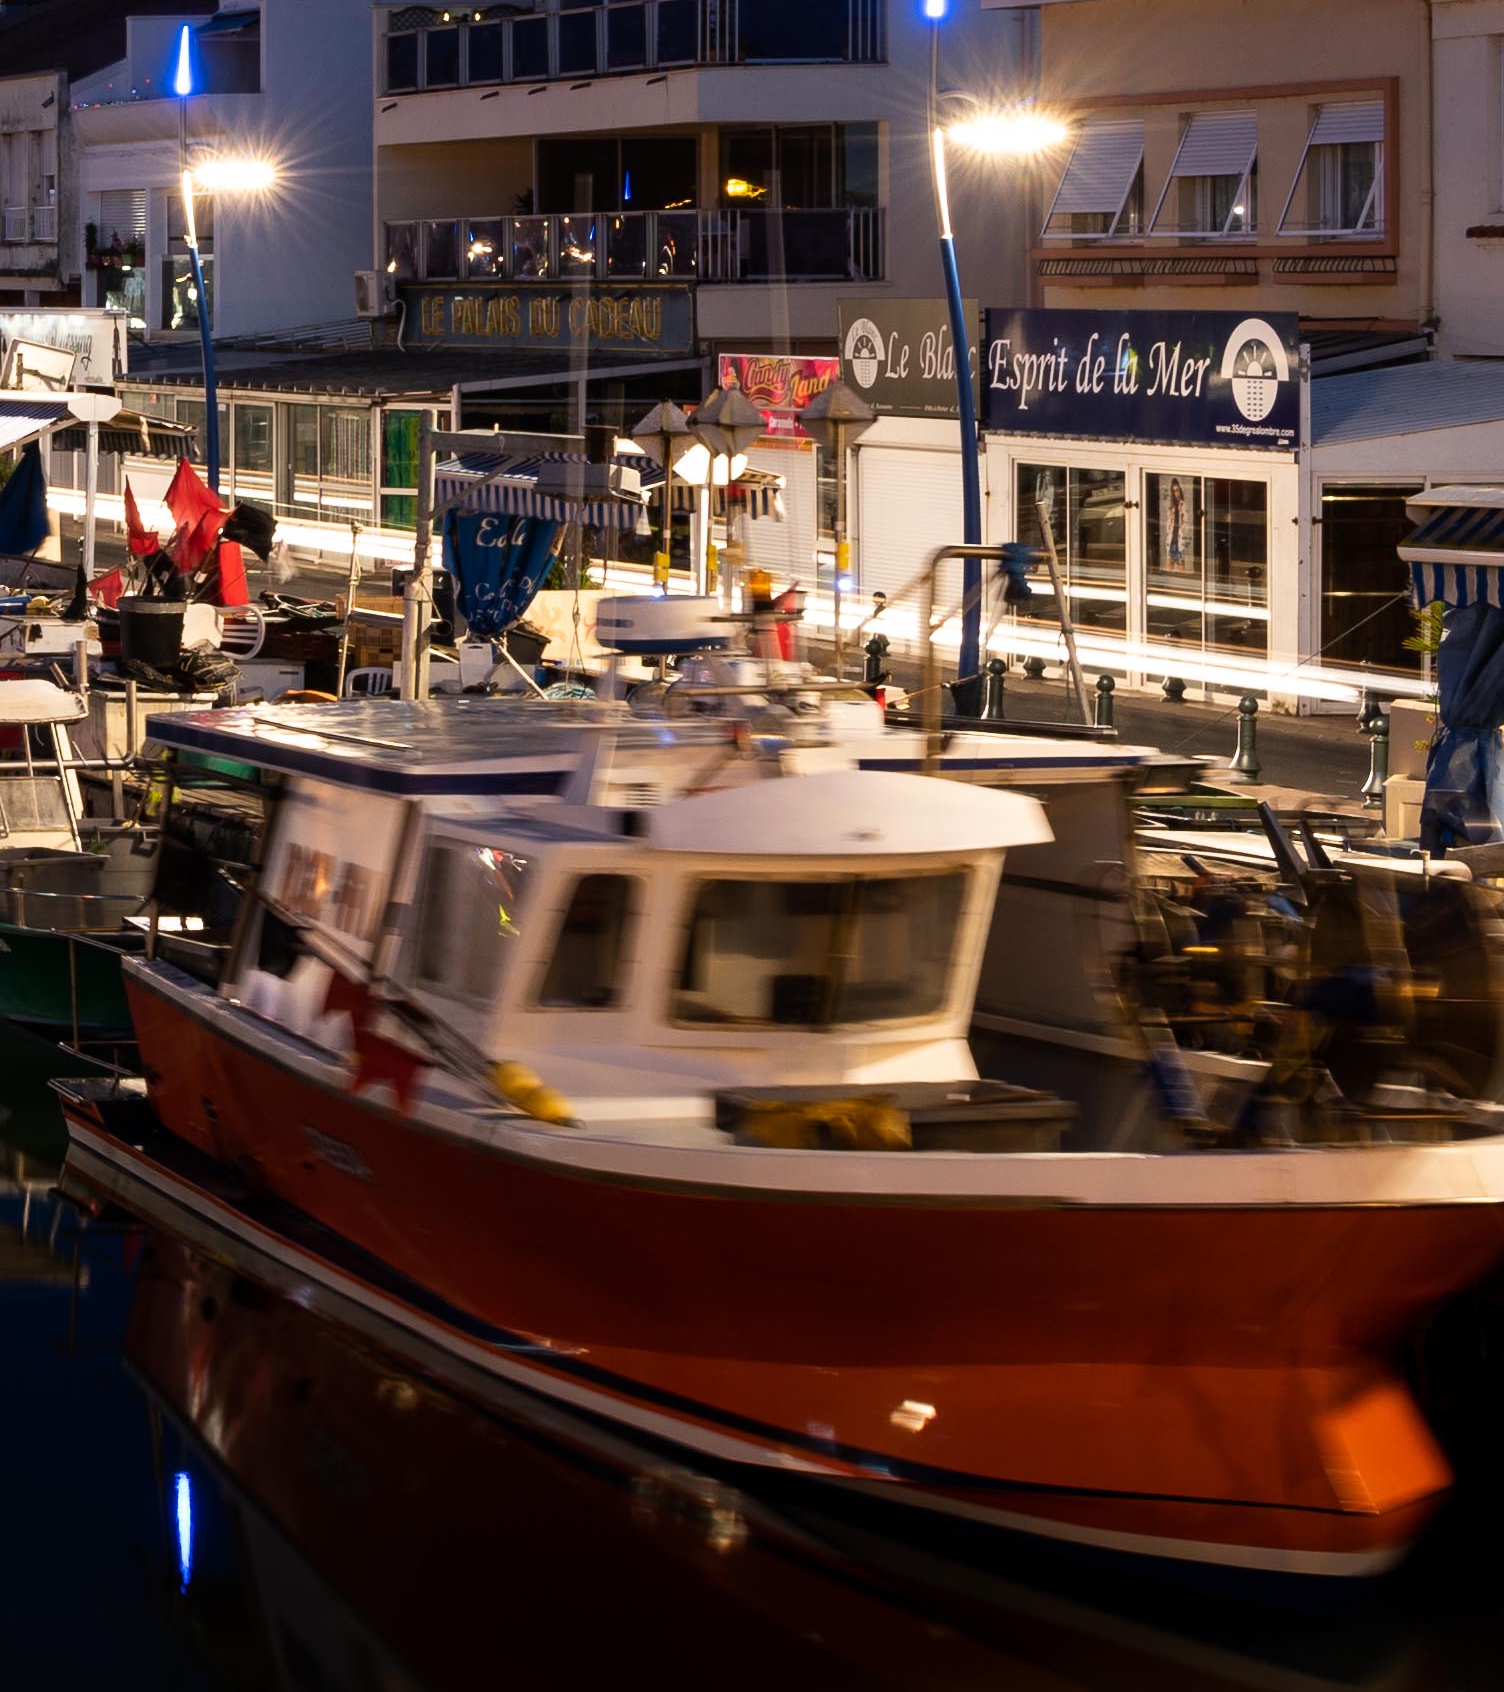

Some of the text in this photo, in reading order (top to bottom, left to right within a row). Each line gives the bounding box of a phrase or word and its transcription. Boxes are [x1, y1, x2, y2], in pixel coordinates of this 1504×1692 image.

[421, 296, 663, 340] LE PALAIS DU CADEAU
[885, 324, 976, 380] Le Blac
[988, 332, 1211, 410] Esprit de la Mer
[743, 357, 832, 399] Candy Land
